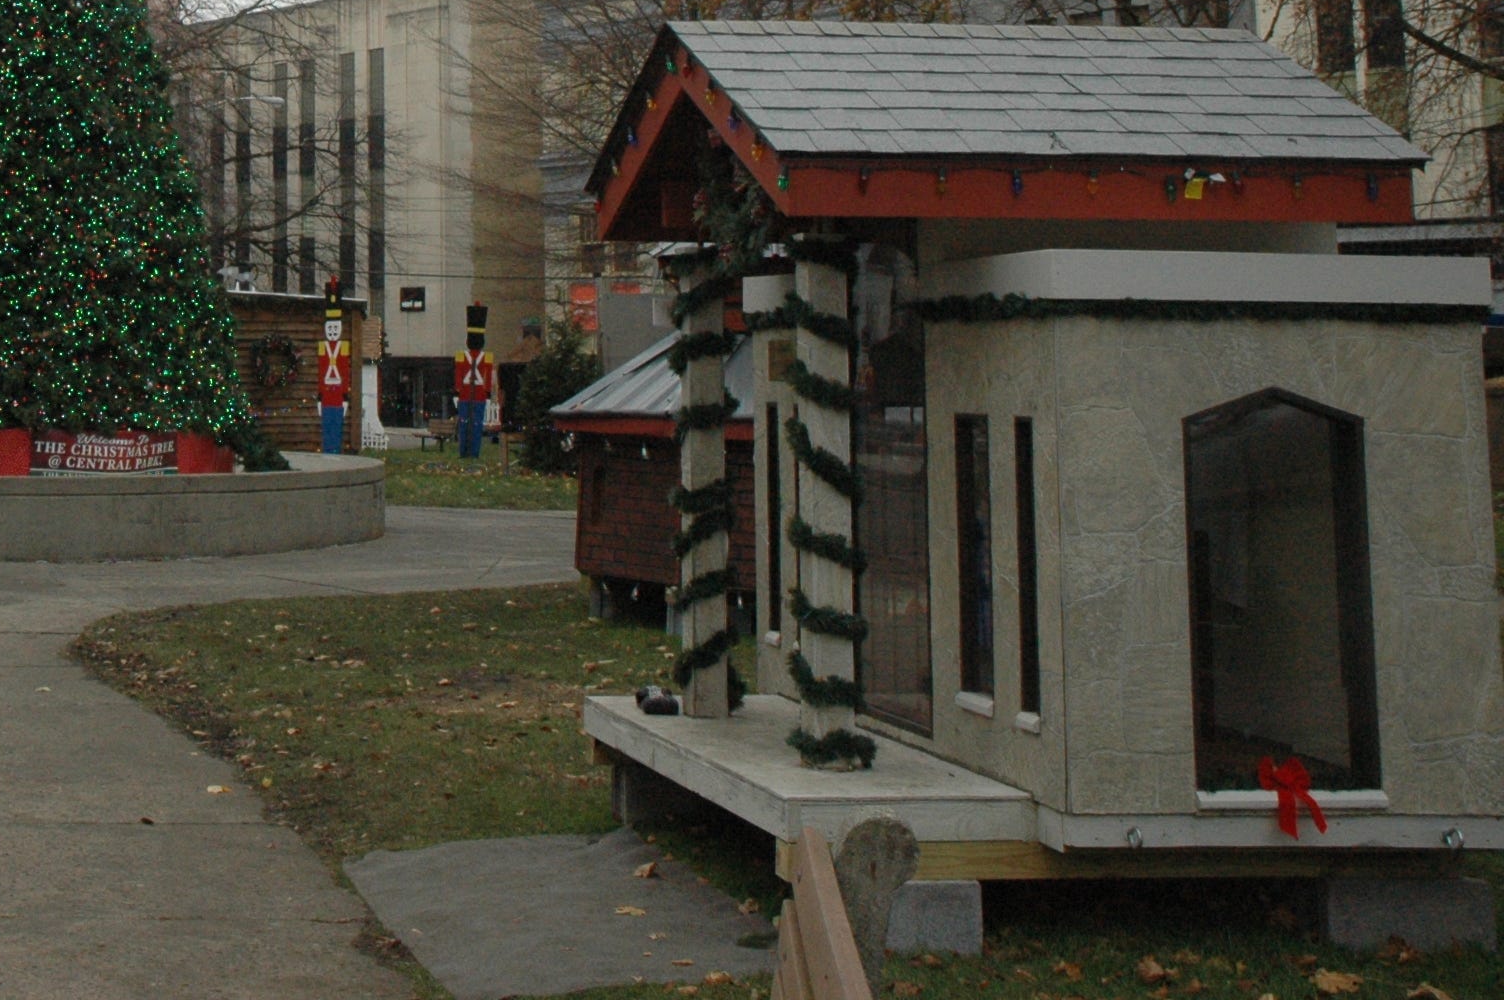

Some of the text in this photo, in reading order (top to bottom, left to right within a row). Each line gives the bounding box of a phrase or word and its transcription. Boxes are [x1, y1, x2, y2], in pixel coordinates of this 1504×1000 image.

[76, 433, 134, 446] Welcome
[34, 440, 175, 458] THE CHRISTMAS TREE
[48, 454, 62, 469] @
[66, 455, 132, 471] CENTRAL
